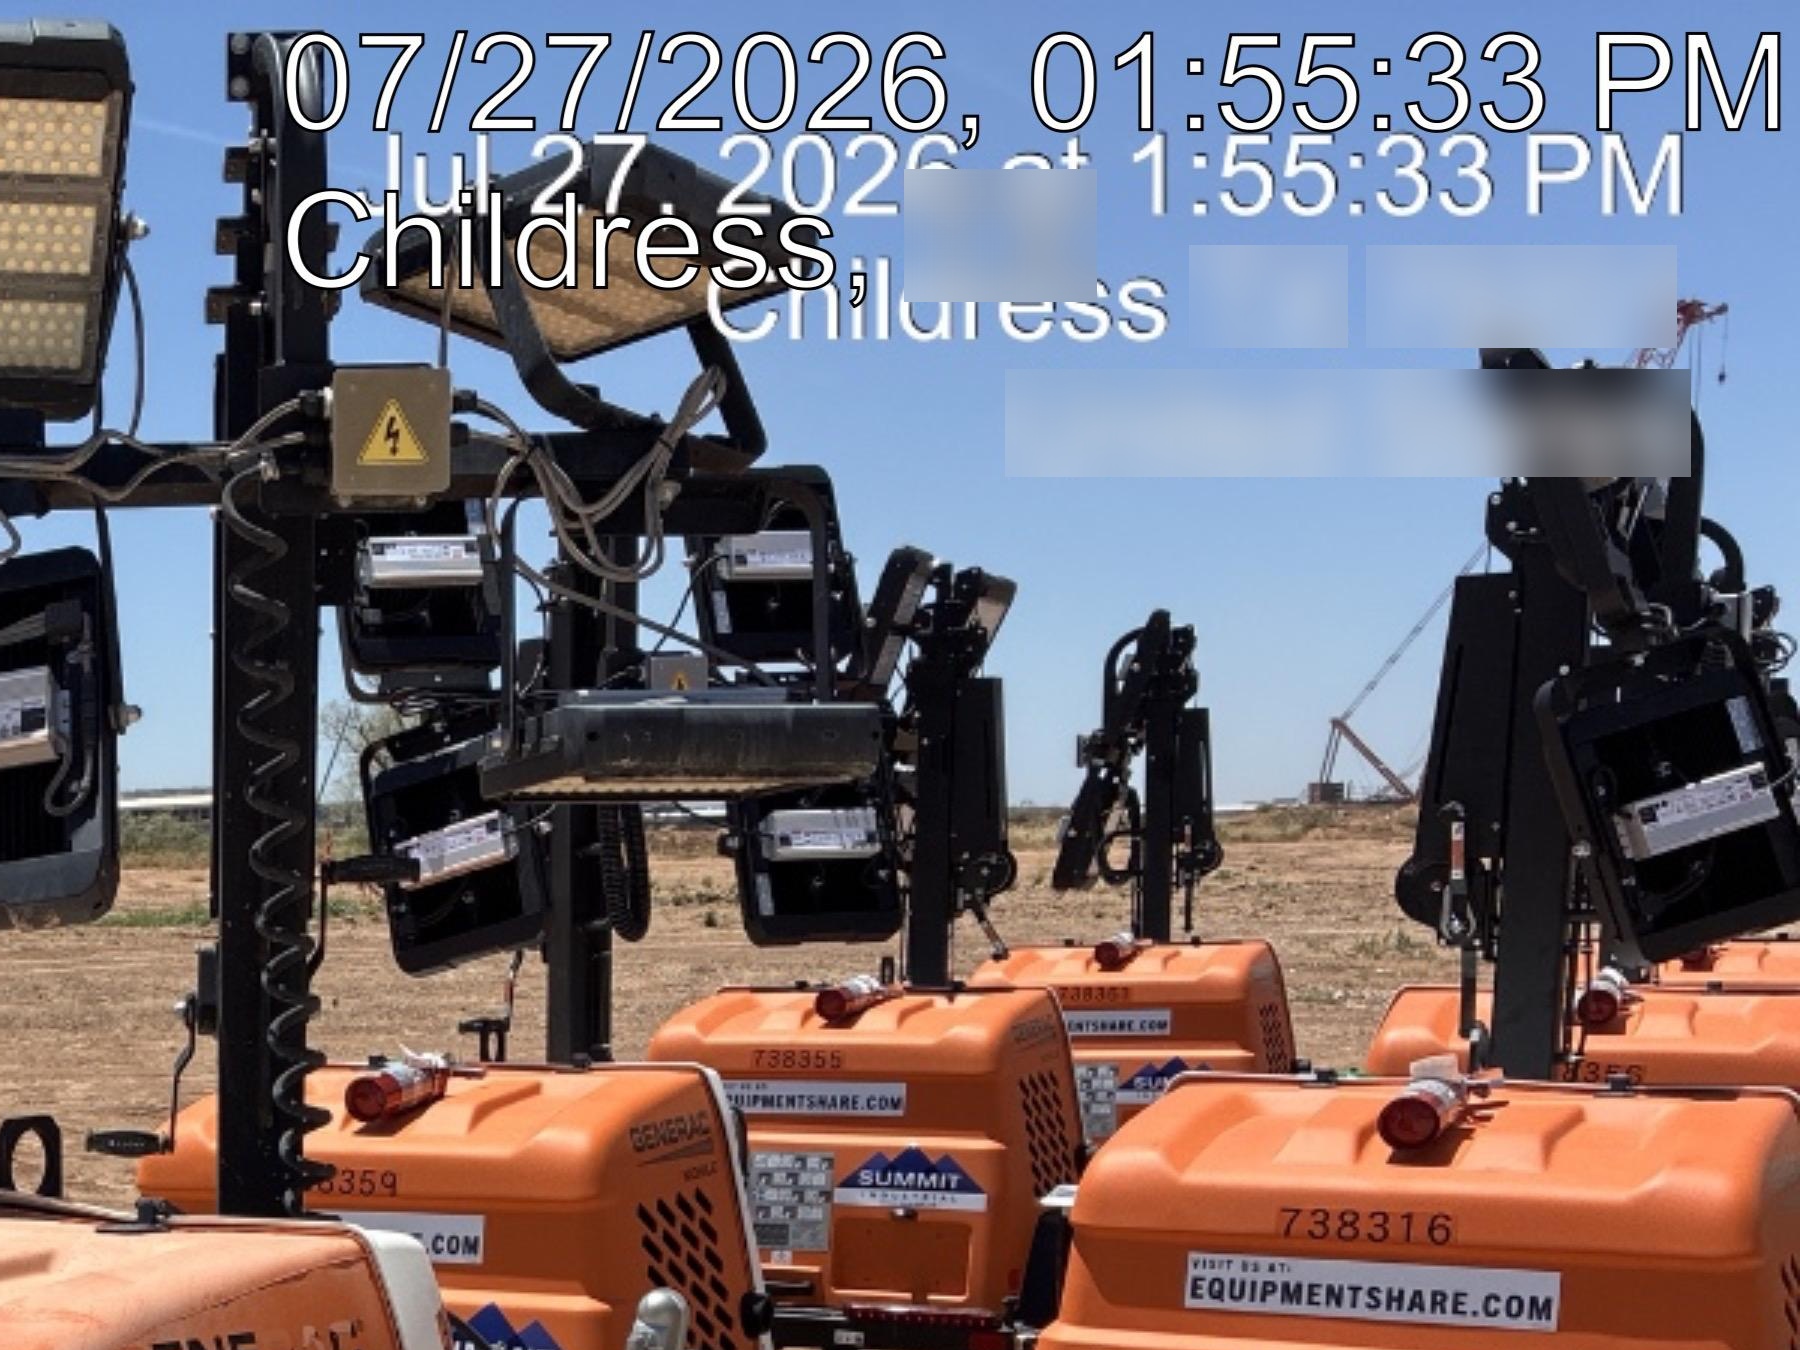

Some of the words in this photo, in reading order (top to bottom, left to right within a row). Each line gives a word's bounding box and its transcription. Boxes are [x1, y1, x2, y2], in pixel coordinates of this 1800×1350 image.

[753, 1050, 842, 1069] 738355
[726, 1093, 903, 1111] UIPMENTSHARE.COM
[306, 1168, 398, 1198] 359
[858, 1168, 963, 1189] SUMMIT
[1280, 1207, 1454, 1246] 738316
[1189, 1276, 1554, 1322] EQUIPMENTSHARE.COM
